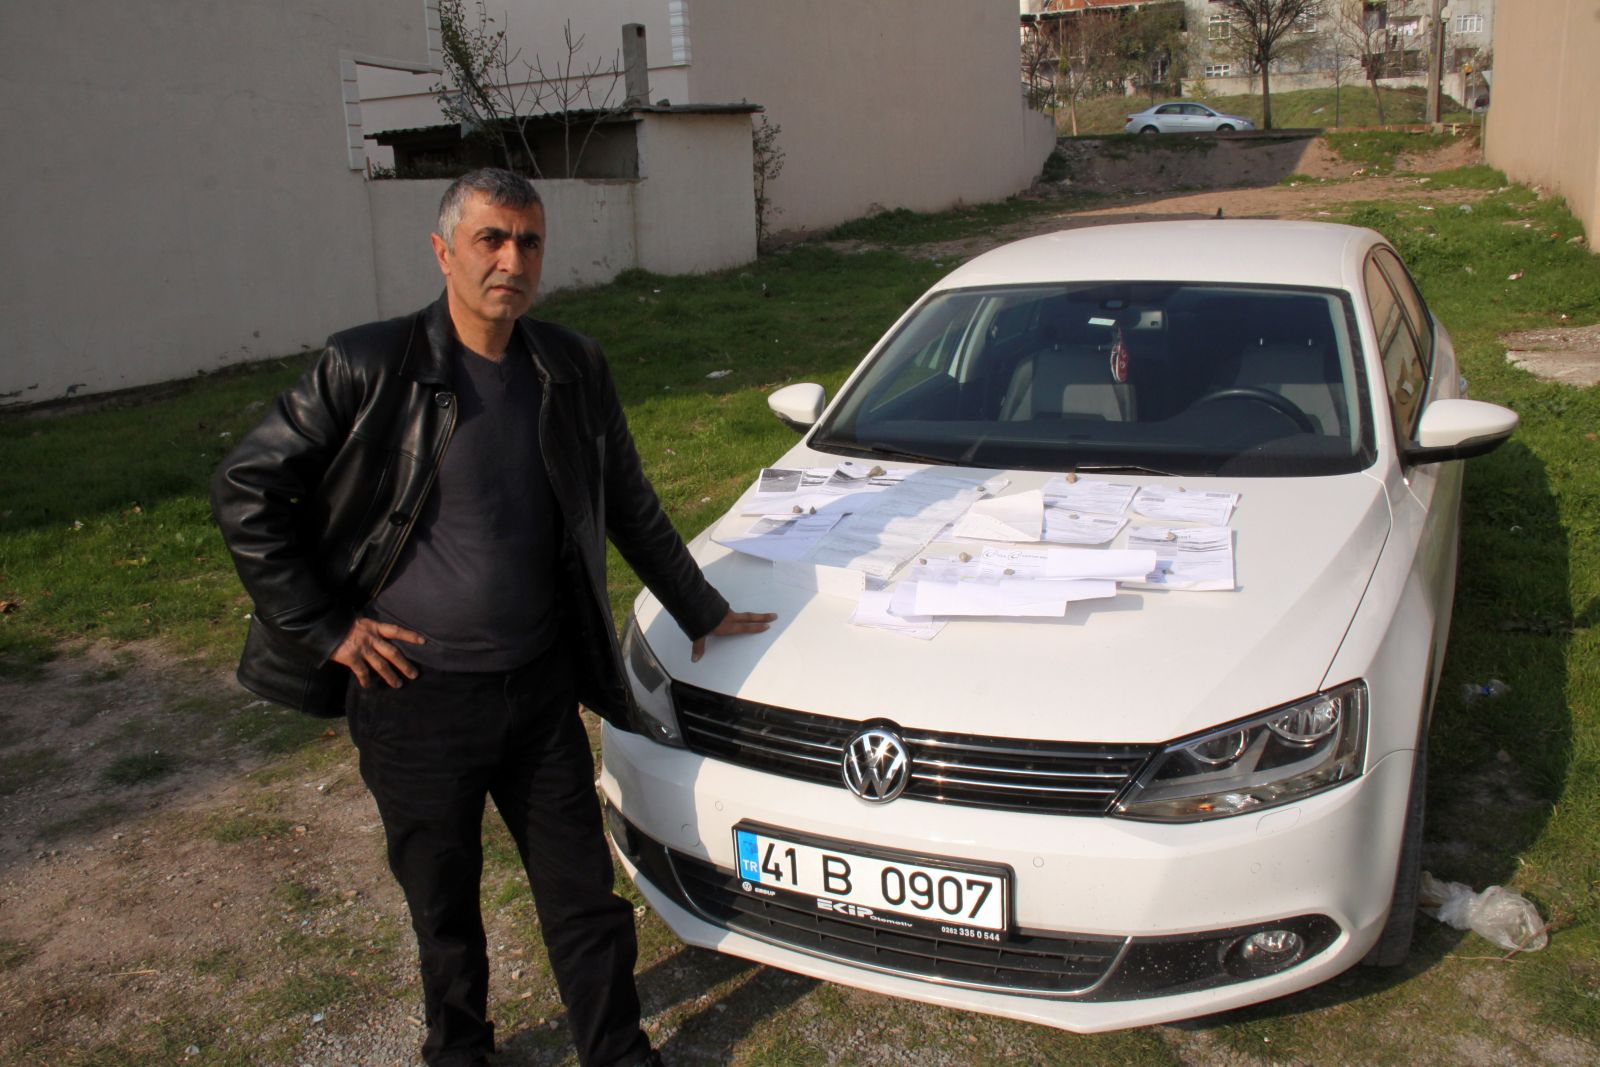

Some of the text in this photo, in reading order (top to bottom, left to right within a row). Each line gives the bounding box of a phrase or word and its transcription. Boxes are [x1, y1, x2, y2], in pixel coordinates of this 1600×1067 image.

[743, 859, 758, 873] TR
[761, 843, 993, 919] 41 B 0907
